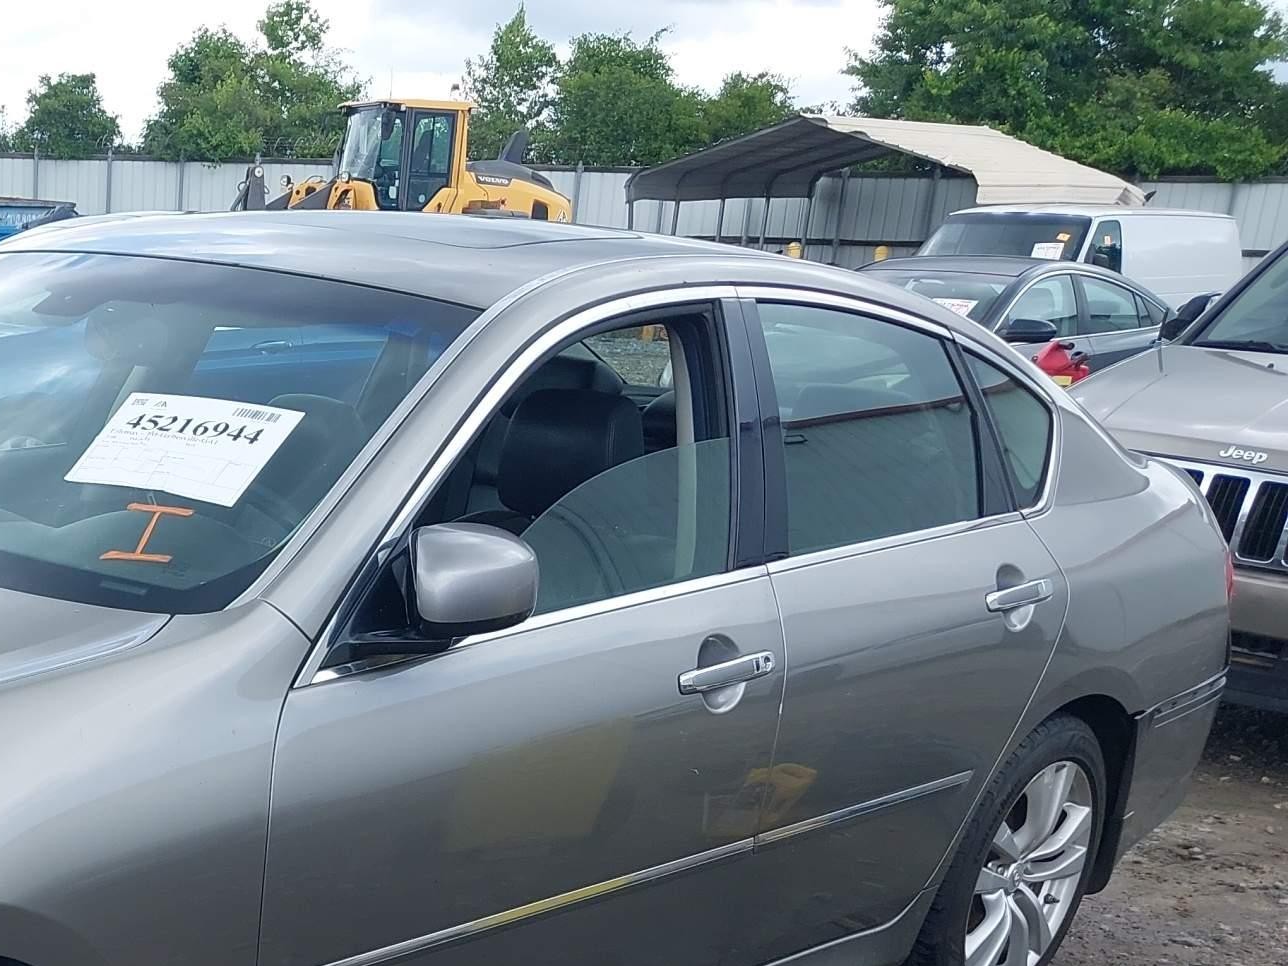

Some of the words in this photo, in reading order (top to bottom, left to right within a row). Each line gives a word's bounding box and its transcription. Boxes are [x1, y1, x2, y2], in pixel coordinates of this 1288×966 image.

[477, 175, 509, 184] VOLVO
[126, 413, 265, 445] 45216944
[1219, 445, 1268, 464] Jeep
